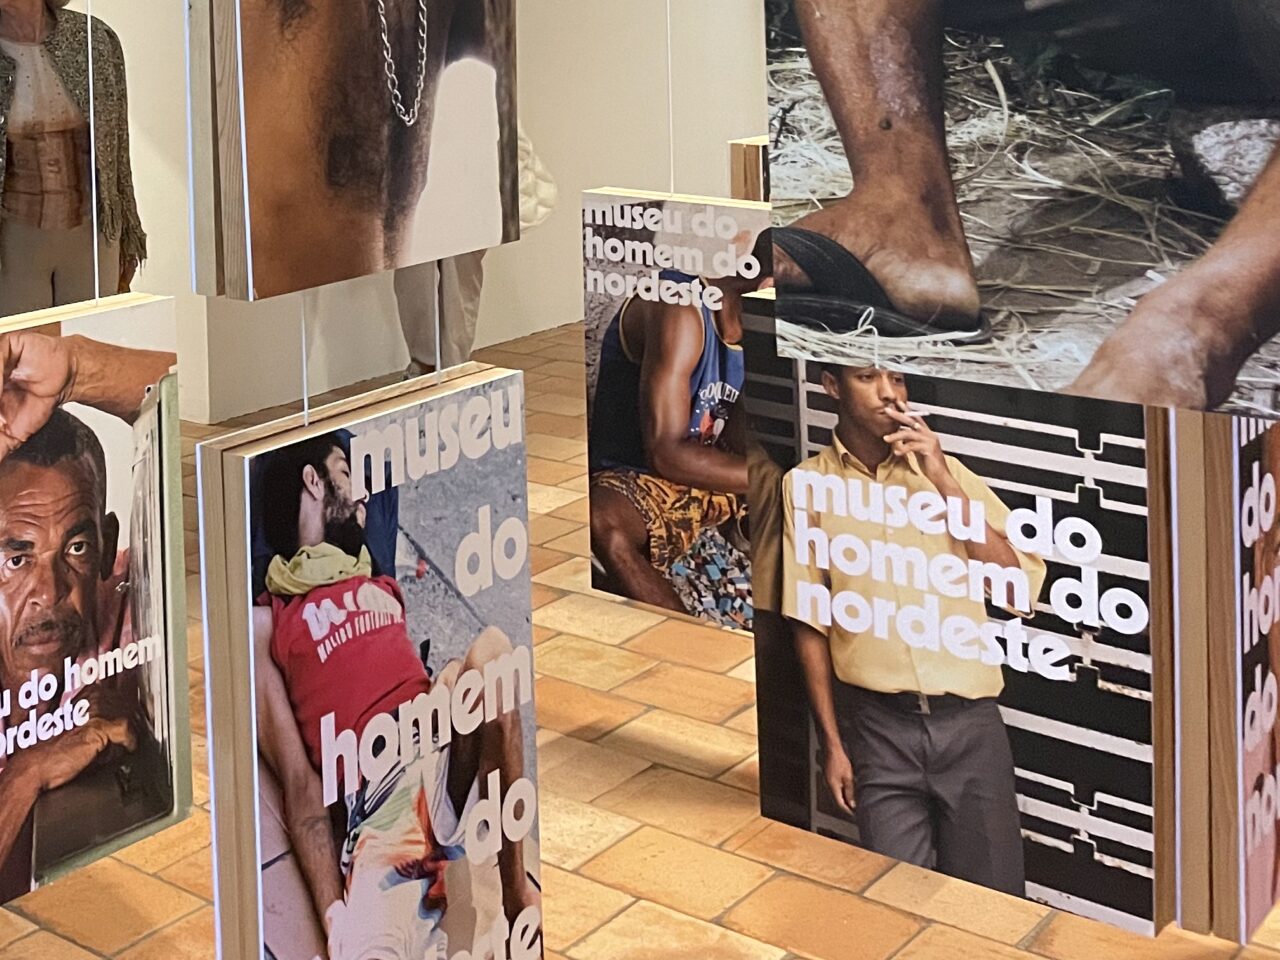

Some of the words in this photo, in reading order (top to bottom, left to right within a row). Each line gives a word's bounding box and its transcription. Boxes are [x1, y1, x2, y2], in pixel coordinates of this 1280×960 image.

[583, 205, 684, 234] museu
[691, 205, 739, 240] do
[585, 227, 704, 272] homem
[712, 243, 761, 279] do
[586, 269, 724, 311] nordeste
[350, 383, 522, 502] museu
[455, 504, 528, 597] do
[792, 468, 986, 543] museu
[1006, 495, 1102, 565] do
[1241, 461, 1276, 548] do
[793, 509, 1031, 613] homem
[1050, 565, 1149, 635] do
[19, 669, 57, 709] do
[64, 634, 162, 692] homem
[796, 581, 1073, 681] nordeste
[320, 645, 532, 808] homem
[1244, 664, 1278, 752] do
[465, 769, 537, 865] do
